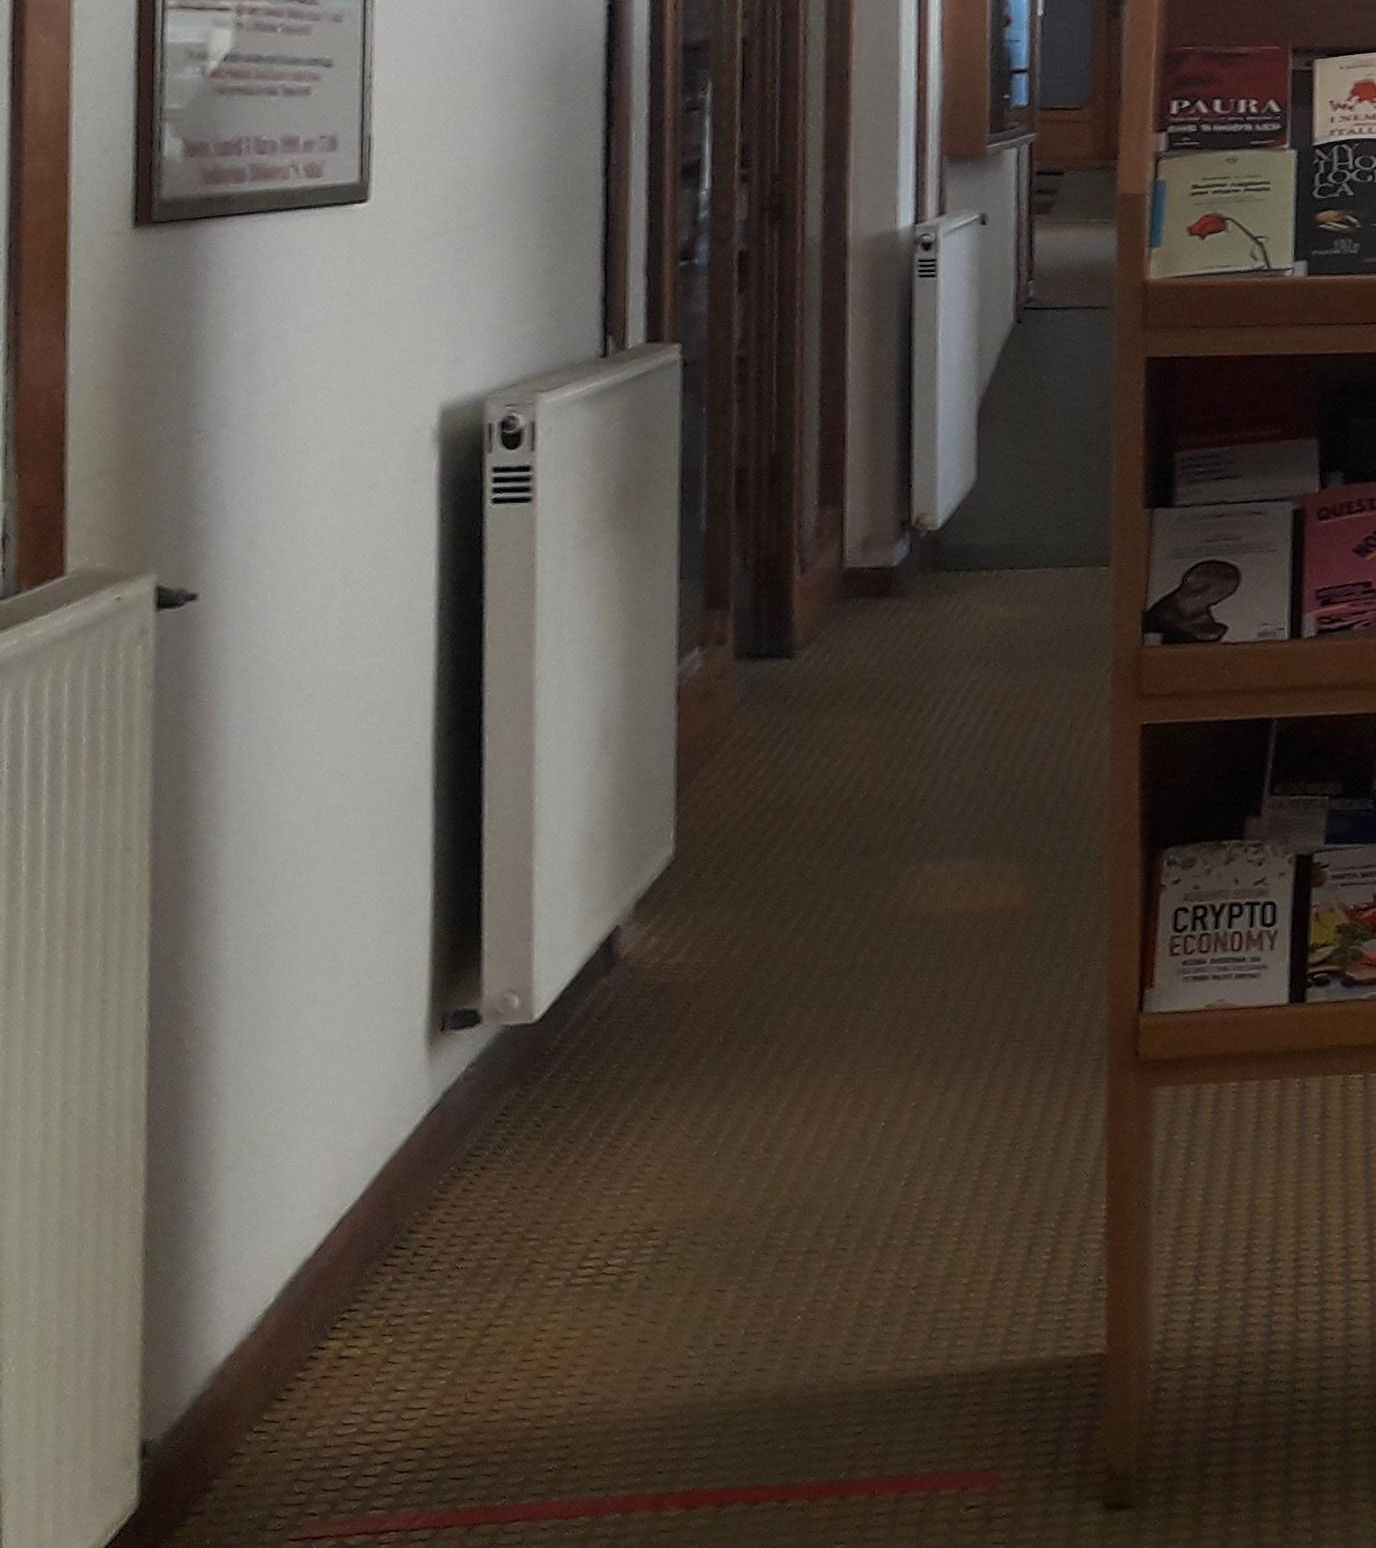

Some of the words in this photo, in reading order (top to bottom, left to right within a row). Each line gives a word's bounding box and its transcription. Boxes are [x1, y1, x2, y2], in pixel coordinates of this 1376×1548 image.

[1169, 99, 1282, 115] PAURA
[1173, 901, 1278, 933] CRYPTO
[1169, 930, 1279, 957] ECONOMY
